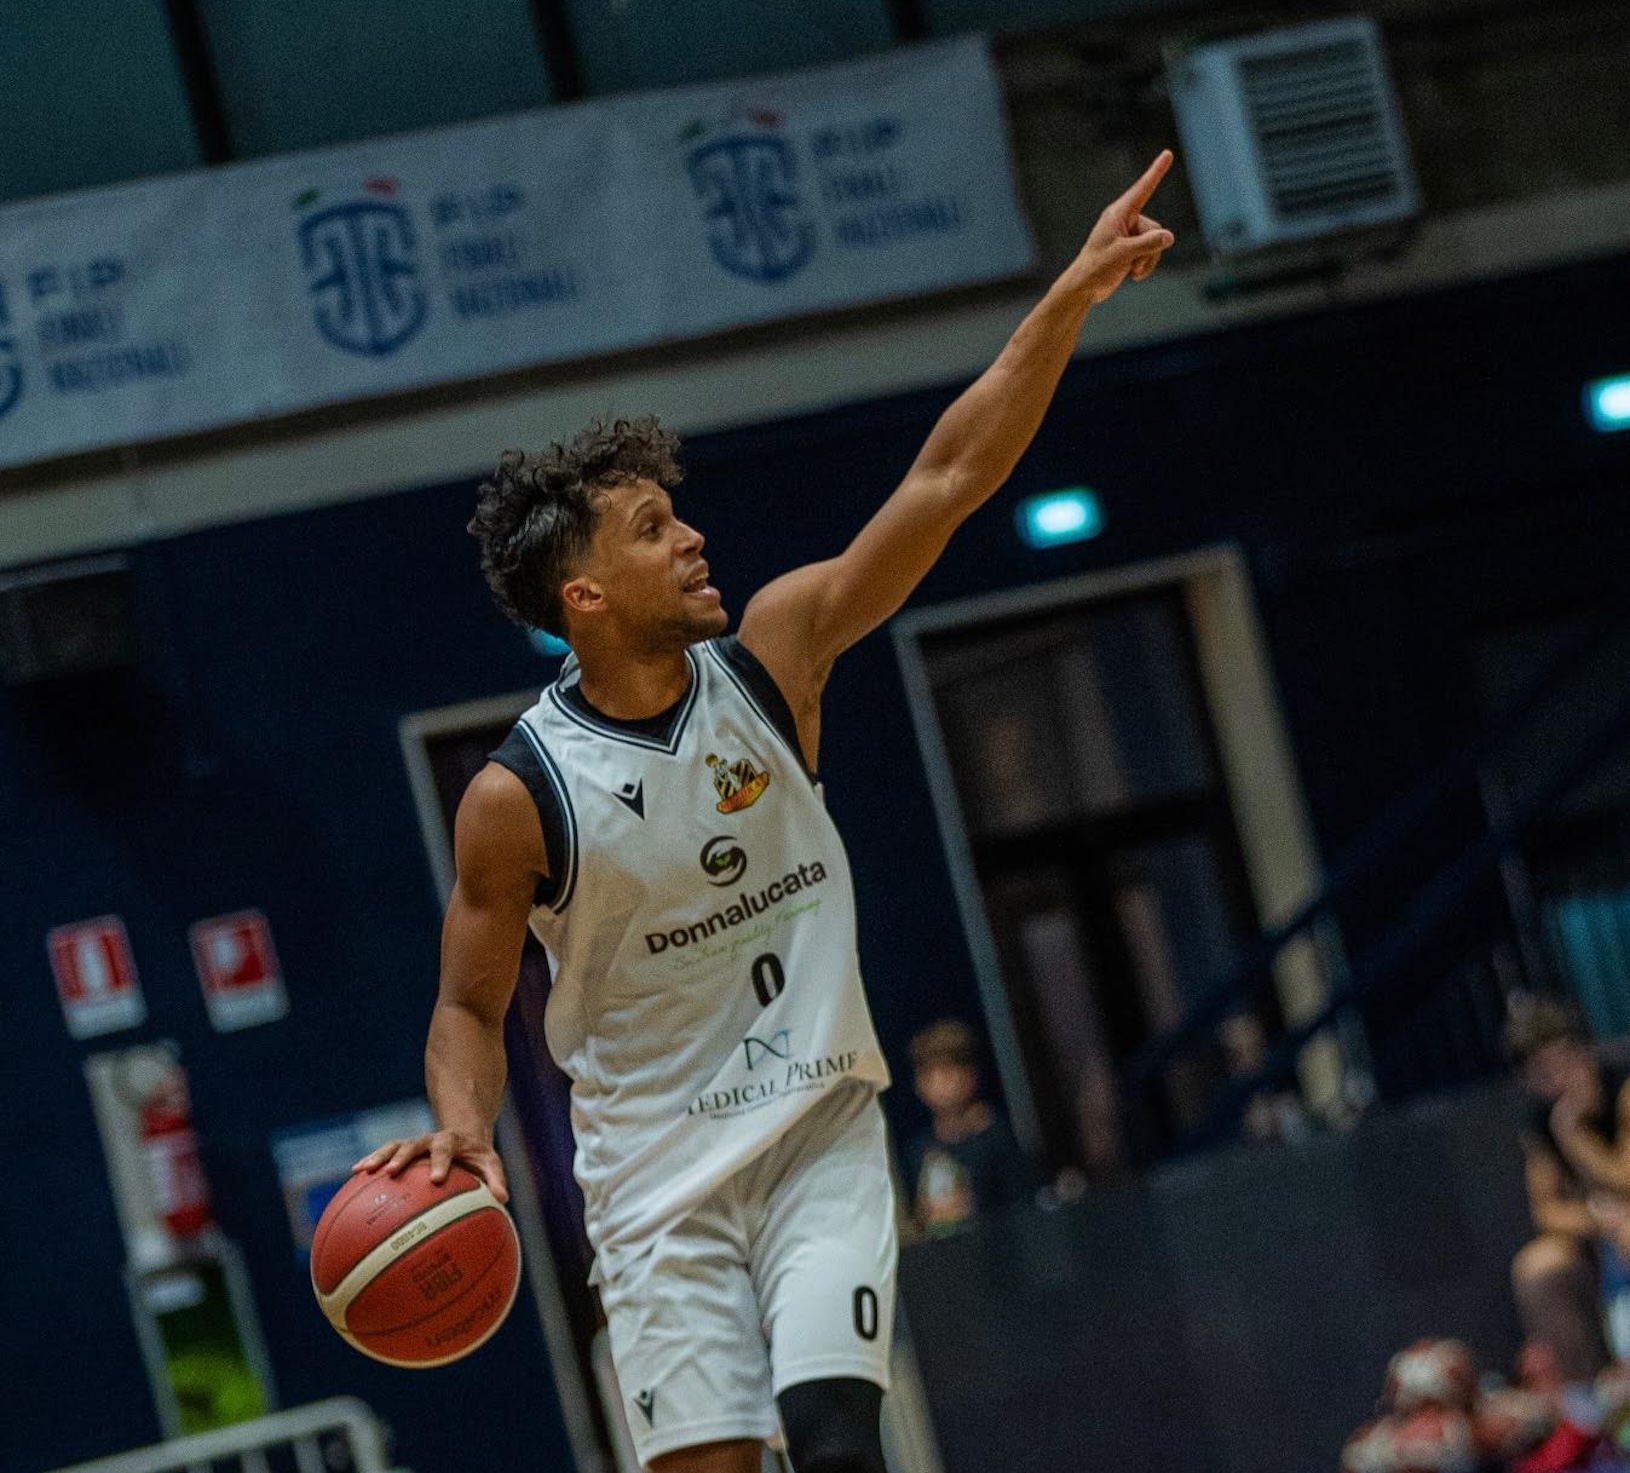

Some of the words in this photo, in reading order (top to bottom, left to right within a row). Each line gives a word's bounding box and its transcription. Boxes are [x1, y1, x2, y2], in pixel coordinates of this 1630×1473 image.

[645, 860, 827, 955] Donnalucata
[751, 952, 786, 1008] 0
[852, 1286, 878, 1340] 0
